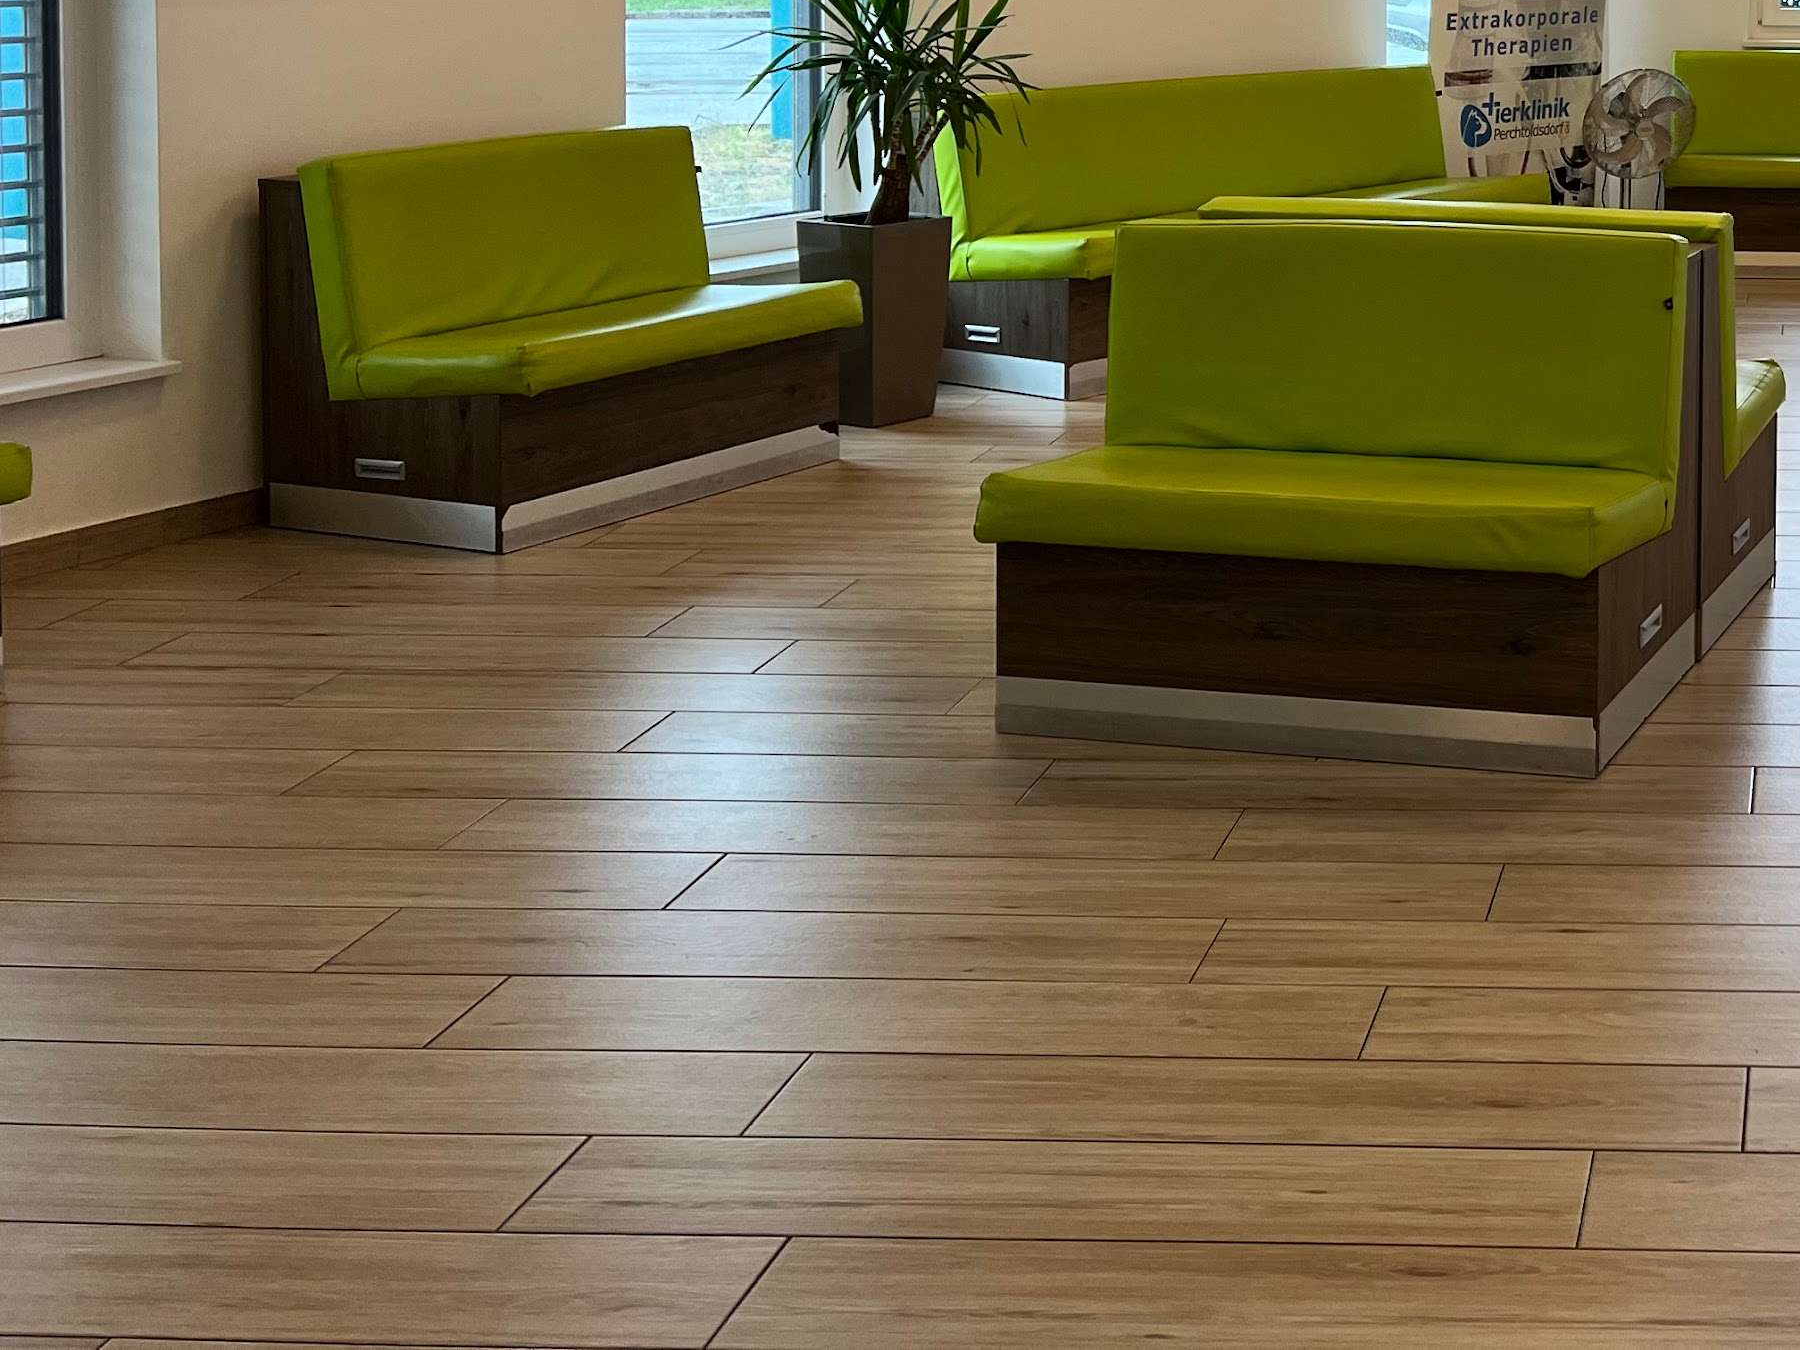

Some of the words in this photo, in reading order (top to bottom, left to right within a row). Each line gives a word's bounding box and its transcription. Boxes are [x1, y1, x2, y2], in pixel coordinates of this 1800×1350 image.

[1446, 6, 1599, 31] Extrakorporale
[1472, 34, 1573, 57] Therapien
[1482, 92, 1570, 124] Tierklinik
[1493, 122, 1564, 140] Perchtoldsdorf
